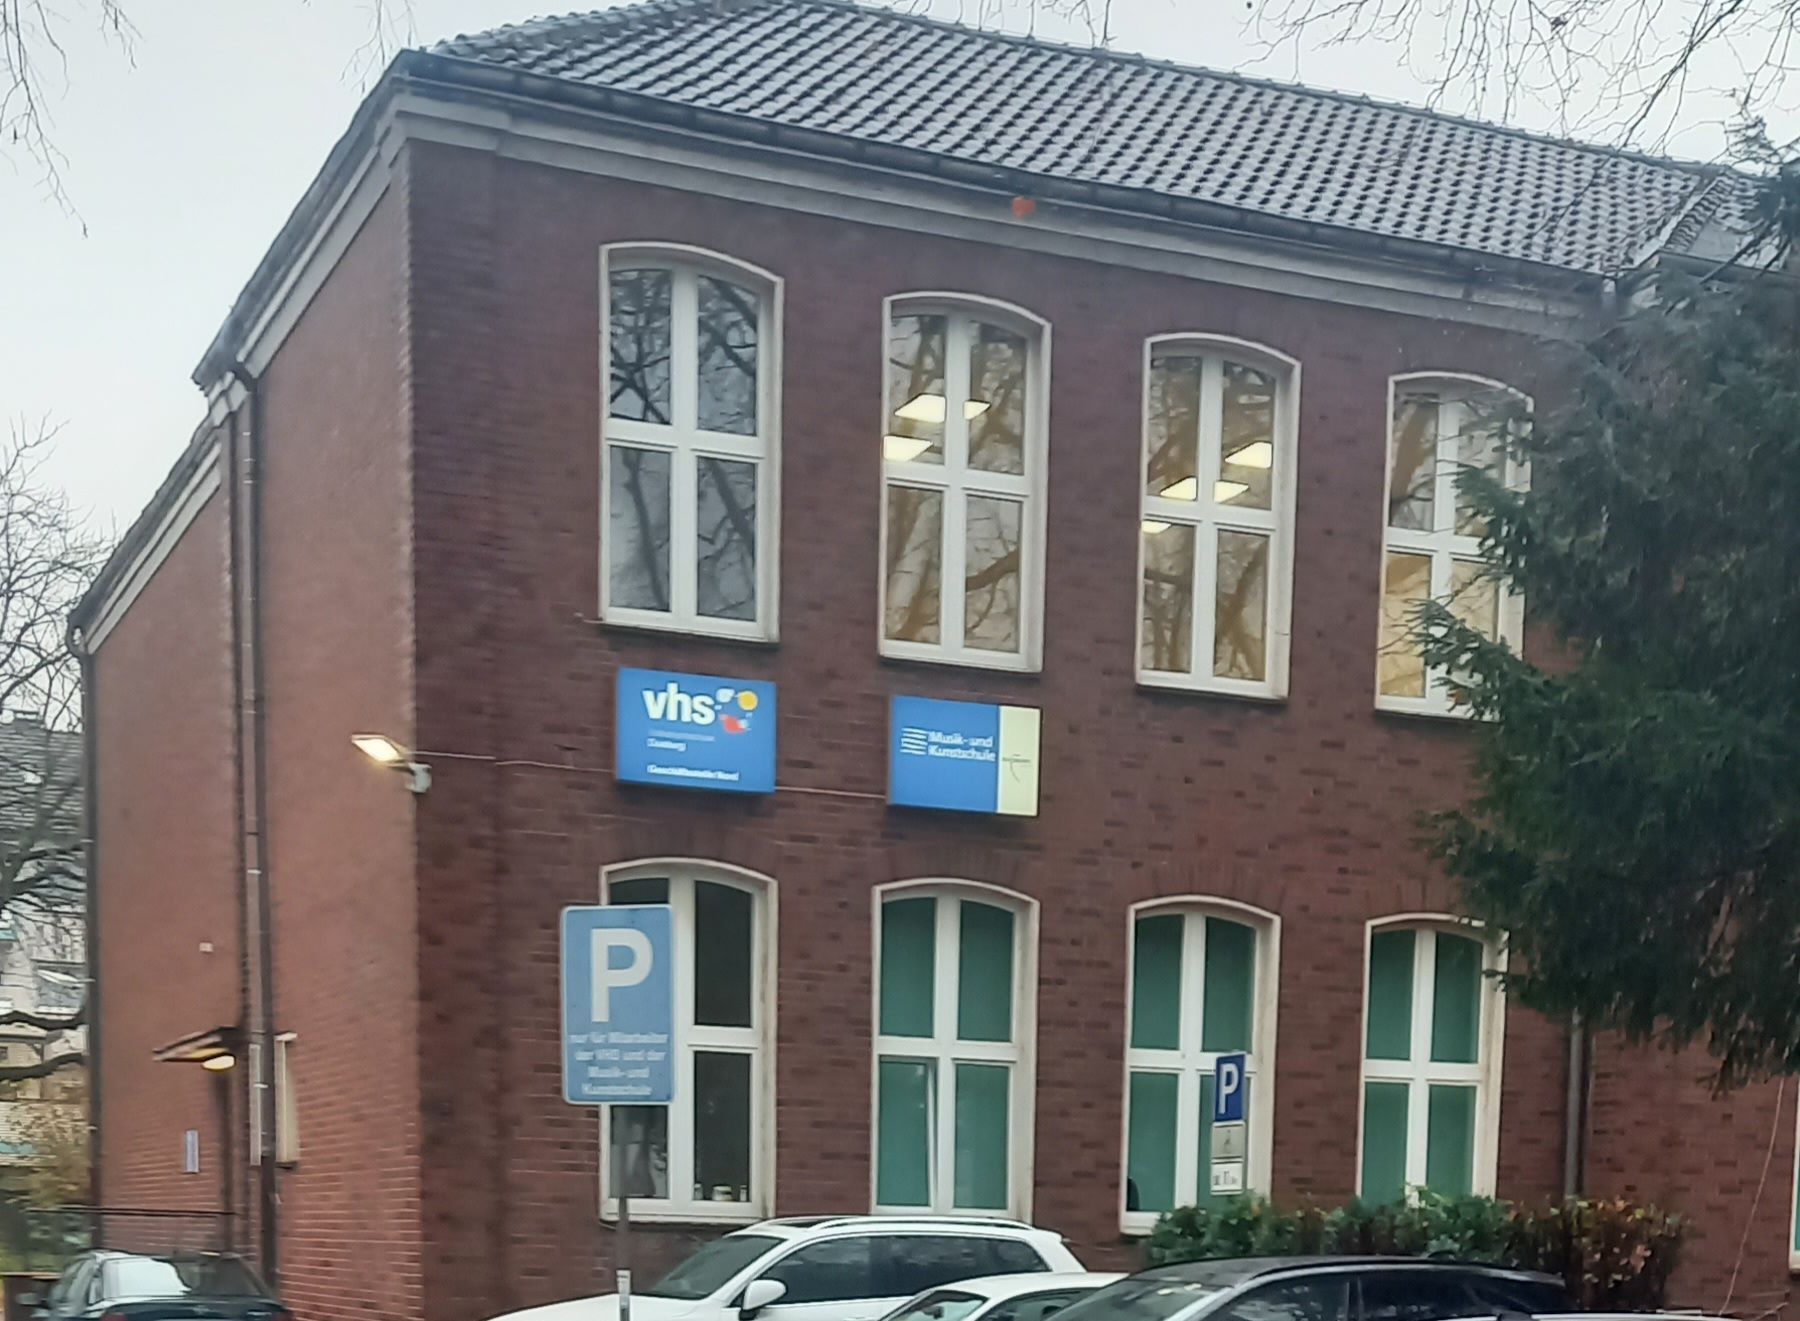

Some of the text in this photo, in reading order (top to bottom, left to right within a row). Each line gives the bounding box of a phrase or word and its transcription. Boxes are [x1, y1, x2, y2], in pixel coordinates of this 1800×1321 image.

[642, 682, 716, 725] vhs
[969, 735, 993, 748] und
[590, 928, 654, 1023] P
[1218, 1062, 1239, 1115] P
